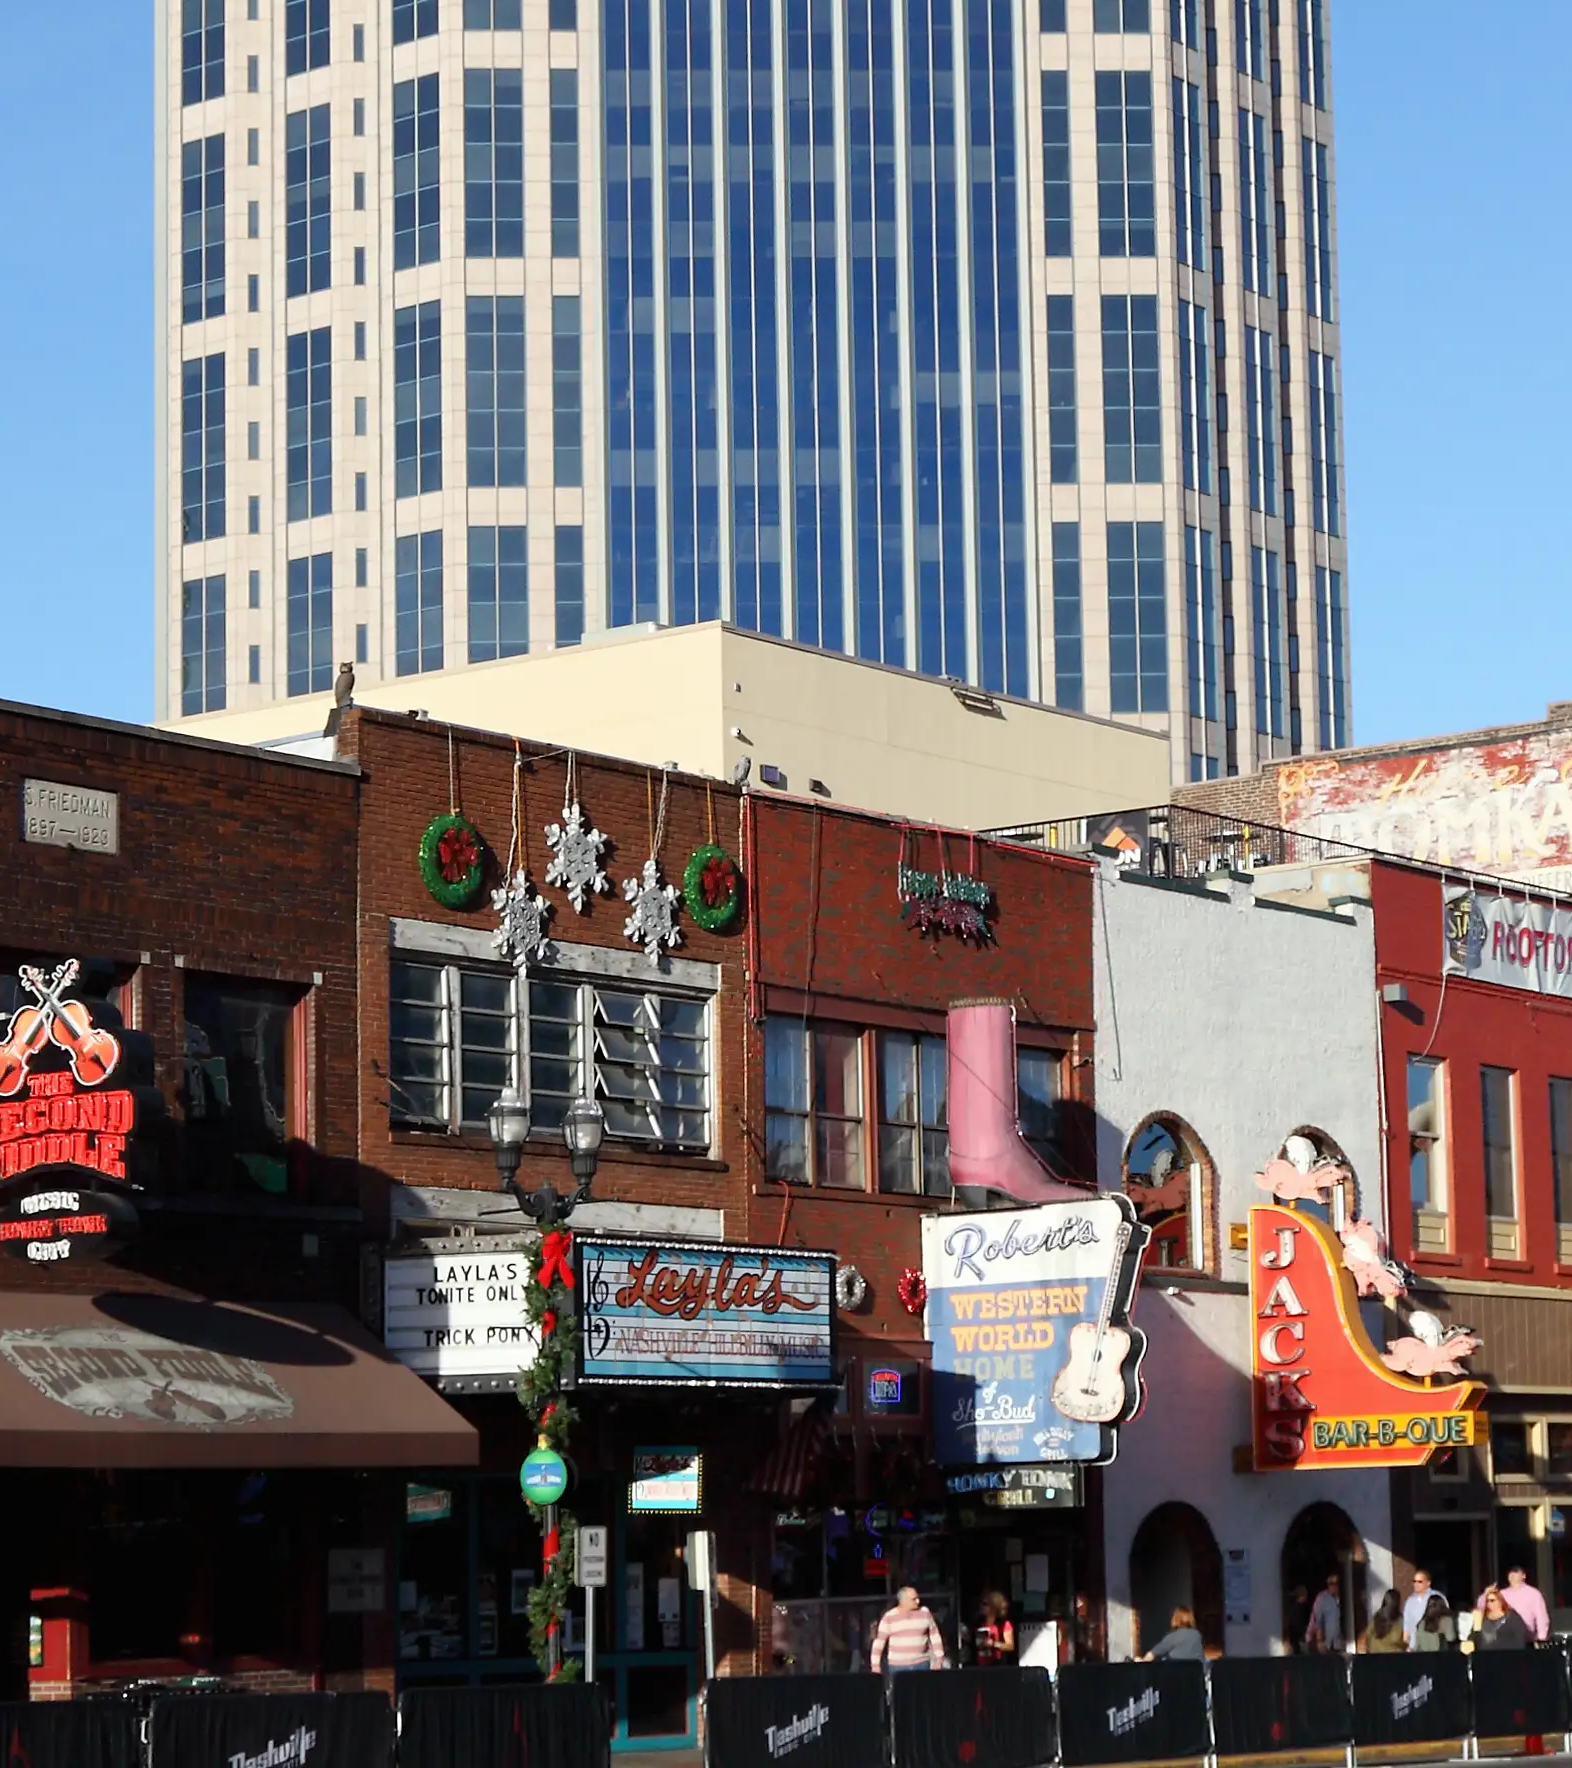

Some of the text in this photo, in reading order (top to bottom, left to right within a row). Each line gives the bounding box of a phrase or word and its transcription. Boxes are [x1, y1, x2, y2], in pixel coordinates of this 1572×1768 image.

[27, 1072, 75, 1097] THE
[944, 1216, 1101, 1282] Robert's
[434, 1263, 518, 1284] LAYLA'S
[614, 1248, 819, 1321] Layla's
[416, 1285, 527, 1306] TONITE ONL
[949, 1284, 1090, 1321] WESTERN
[424, 1328, 476, 1347] TRICK
[950, 1320, 1056, 1354] WORLD
[952, 1354, 1036, 1382] HOME
[1312, 1415, 1468, 1450] BAR-B-QUE
